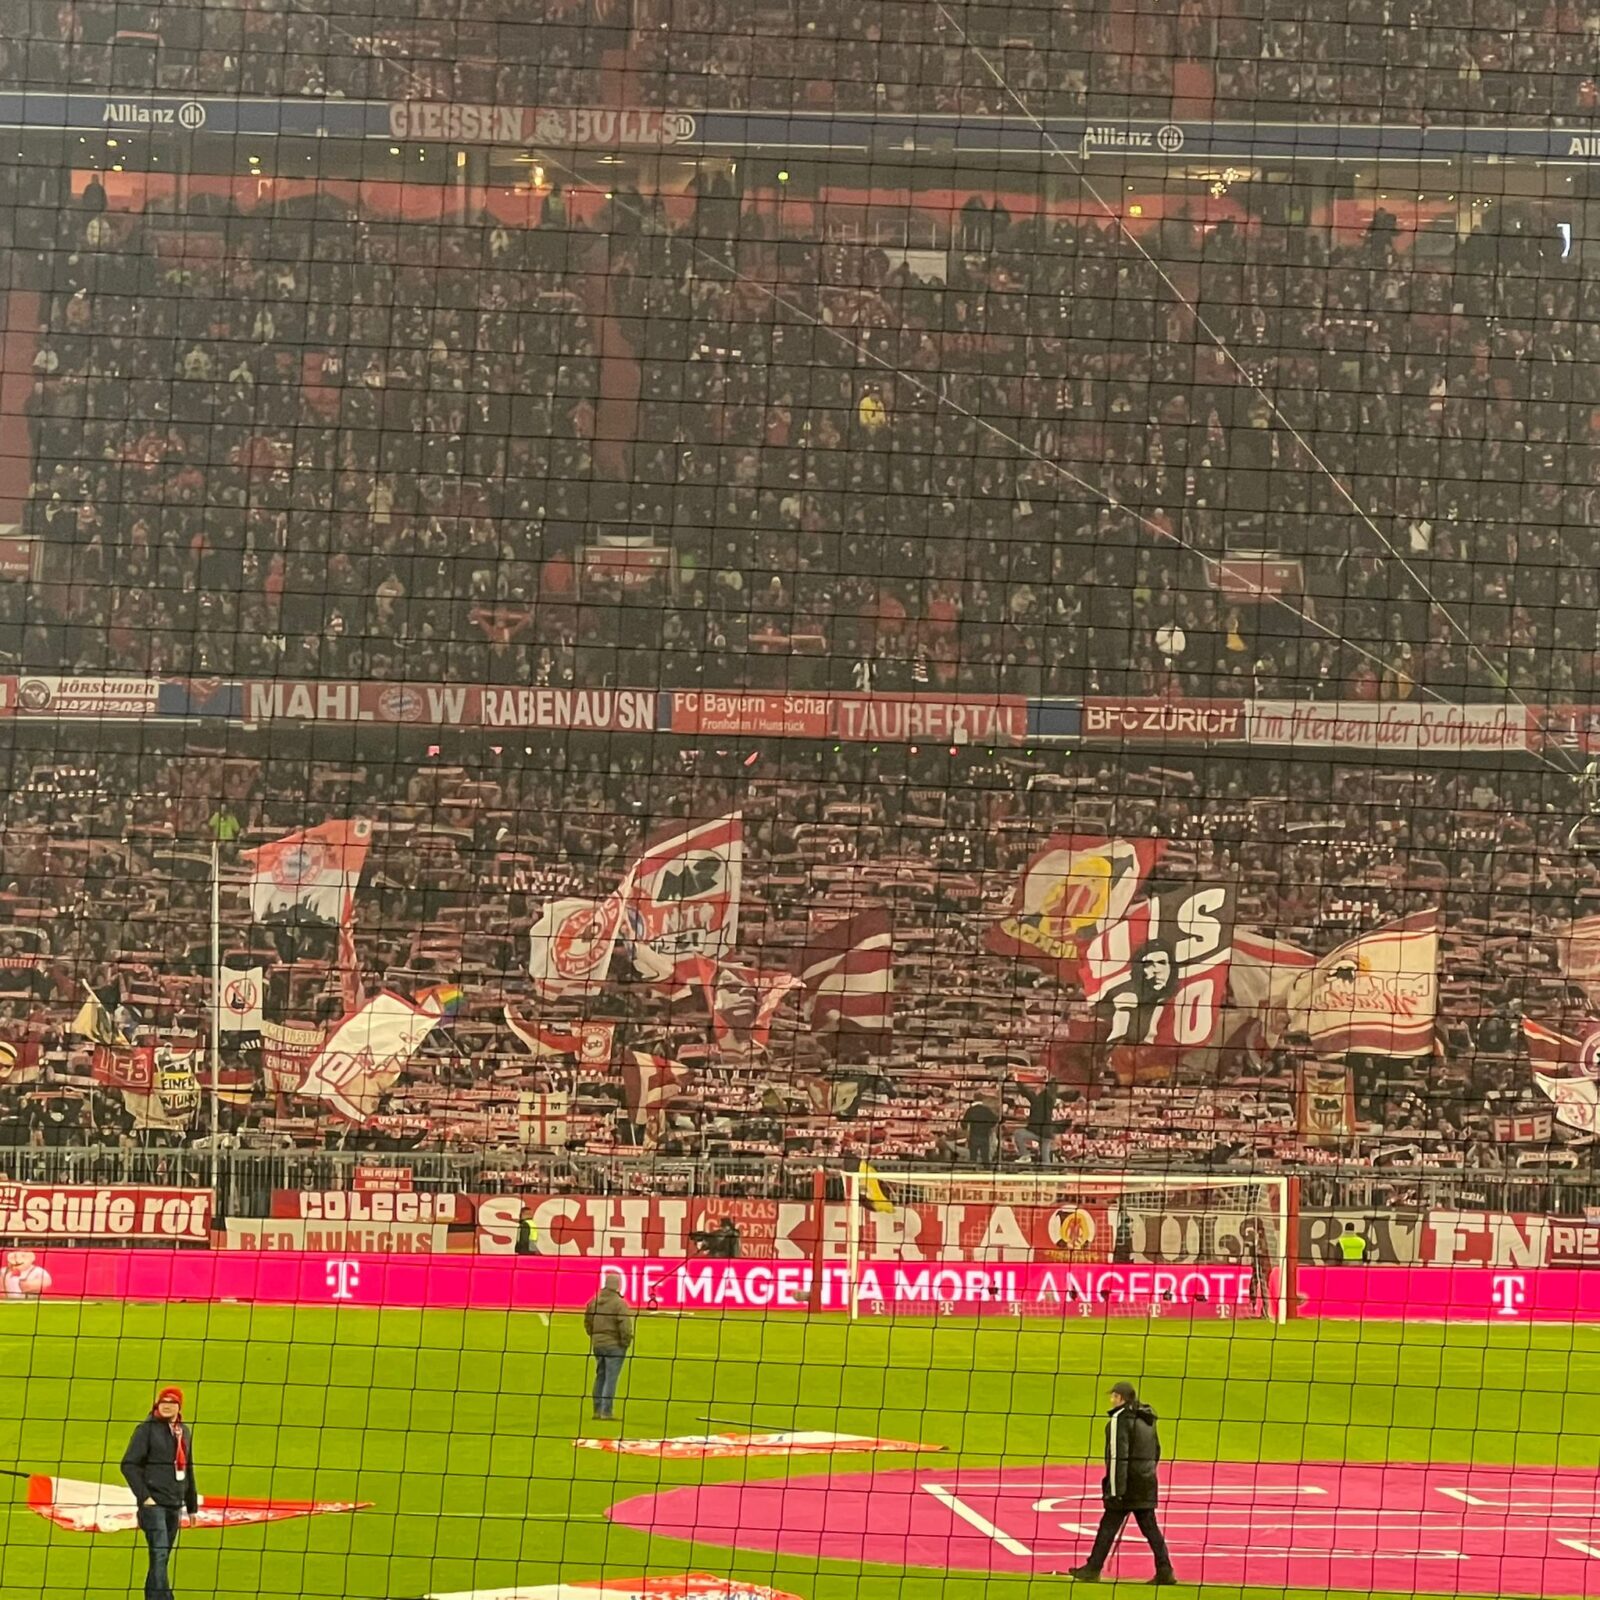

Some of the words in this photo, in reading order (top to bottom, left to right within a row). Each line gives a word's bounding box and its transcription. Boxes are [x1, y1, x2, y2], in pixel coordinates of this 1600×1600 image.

[103, 103, 175, 126] Allianz
[389, 104, 525, 142] GIESSEN
[568, 108, 677, 144] BULLS
[1083, 127, 1152, 147] Allianz
[1568, 137, 1600, 156] All
[674, 693, 698, 712] FC
[704, 694, 765, 717] Bayern
[1087, 706, 1136, 730] BFC
[1143, 706, 1238, 733] ZÜRICH
[1252, 706, 1284, 738] Im
[1290, 707, 1371, 742] Herzen
[1378, 706, 1411, 743] der
[1418, 707, 1519, 747] Schwalm
[142, 1195, 209, 1236] rot
[706, 1199, 777, 1219] ULTRAS
[705, 1219, 776, 1239] GGEN
